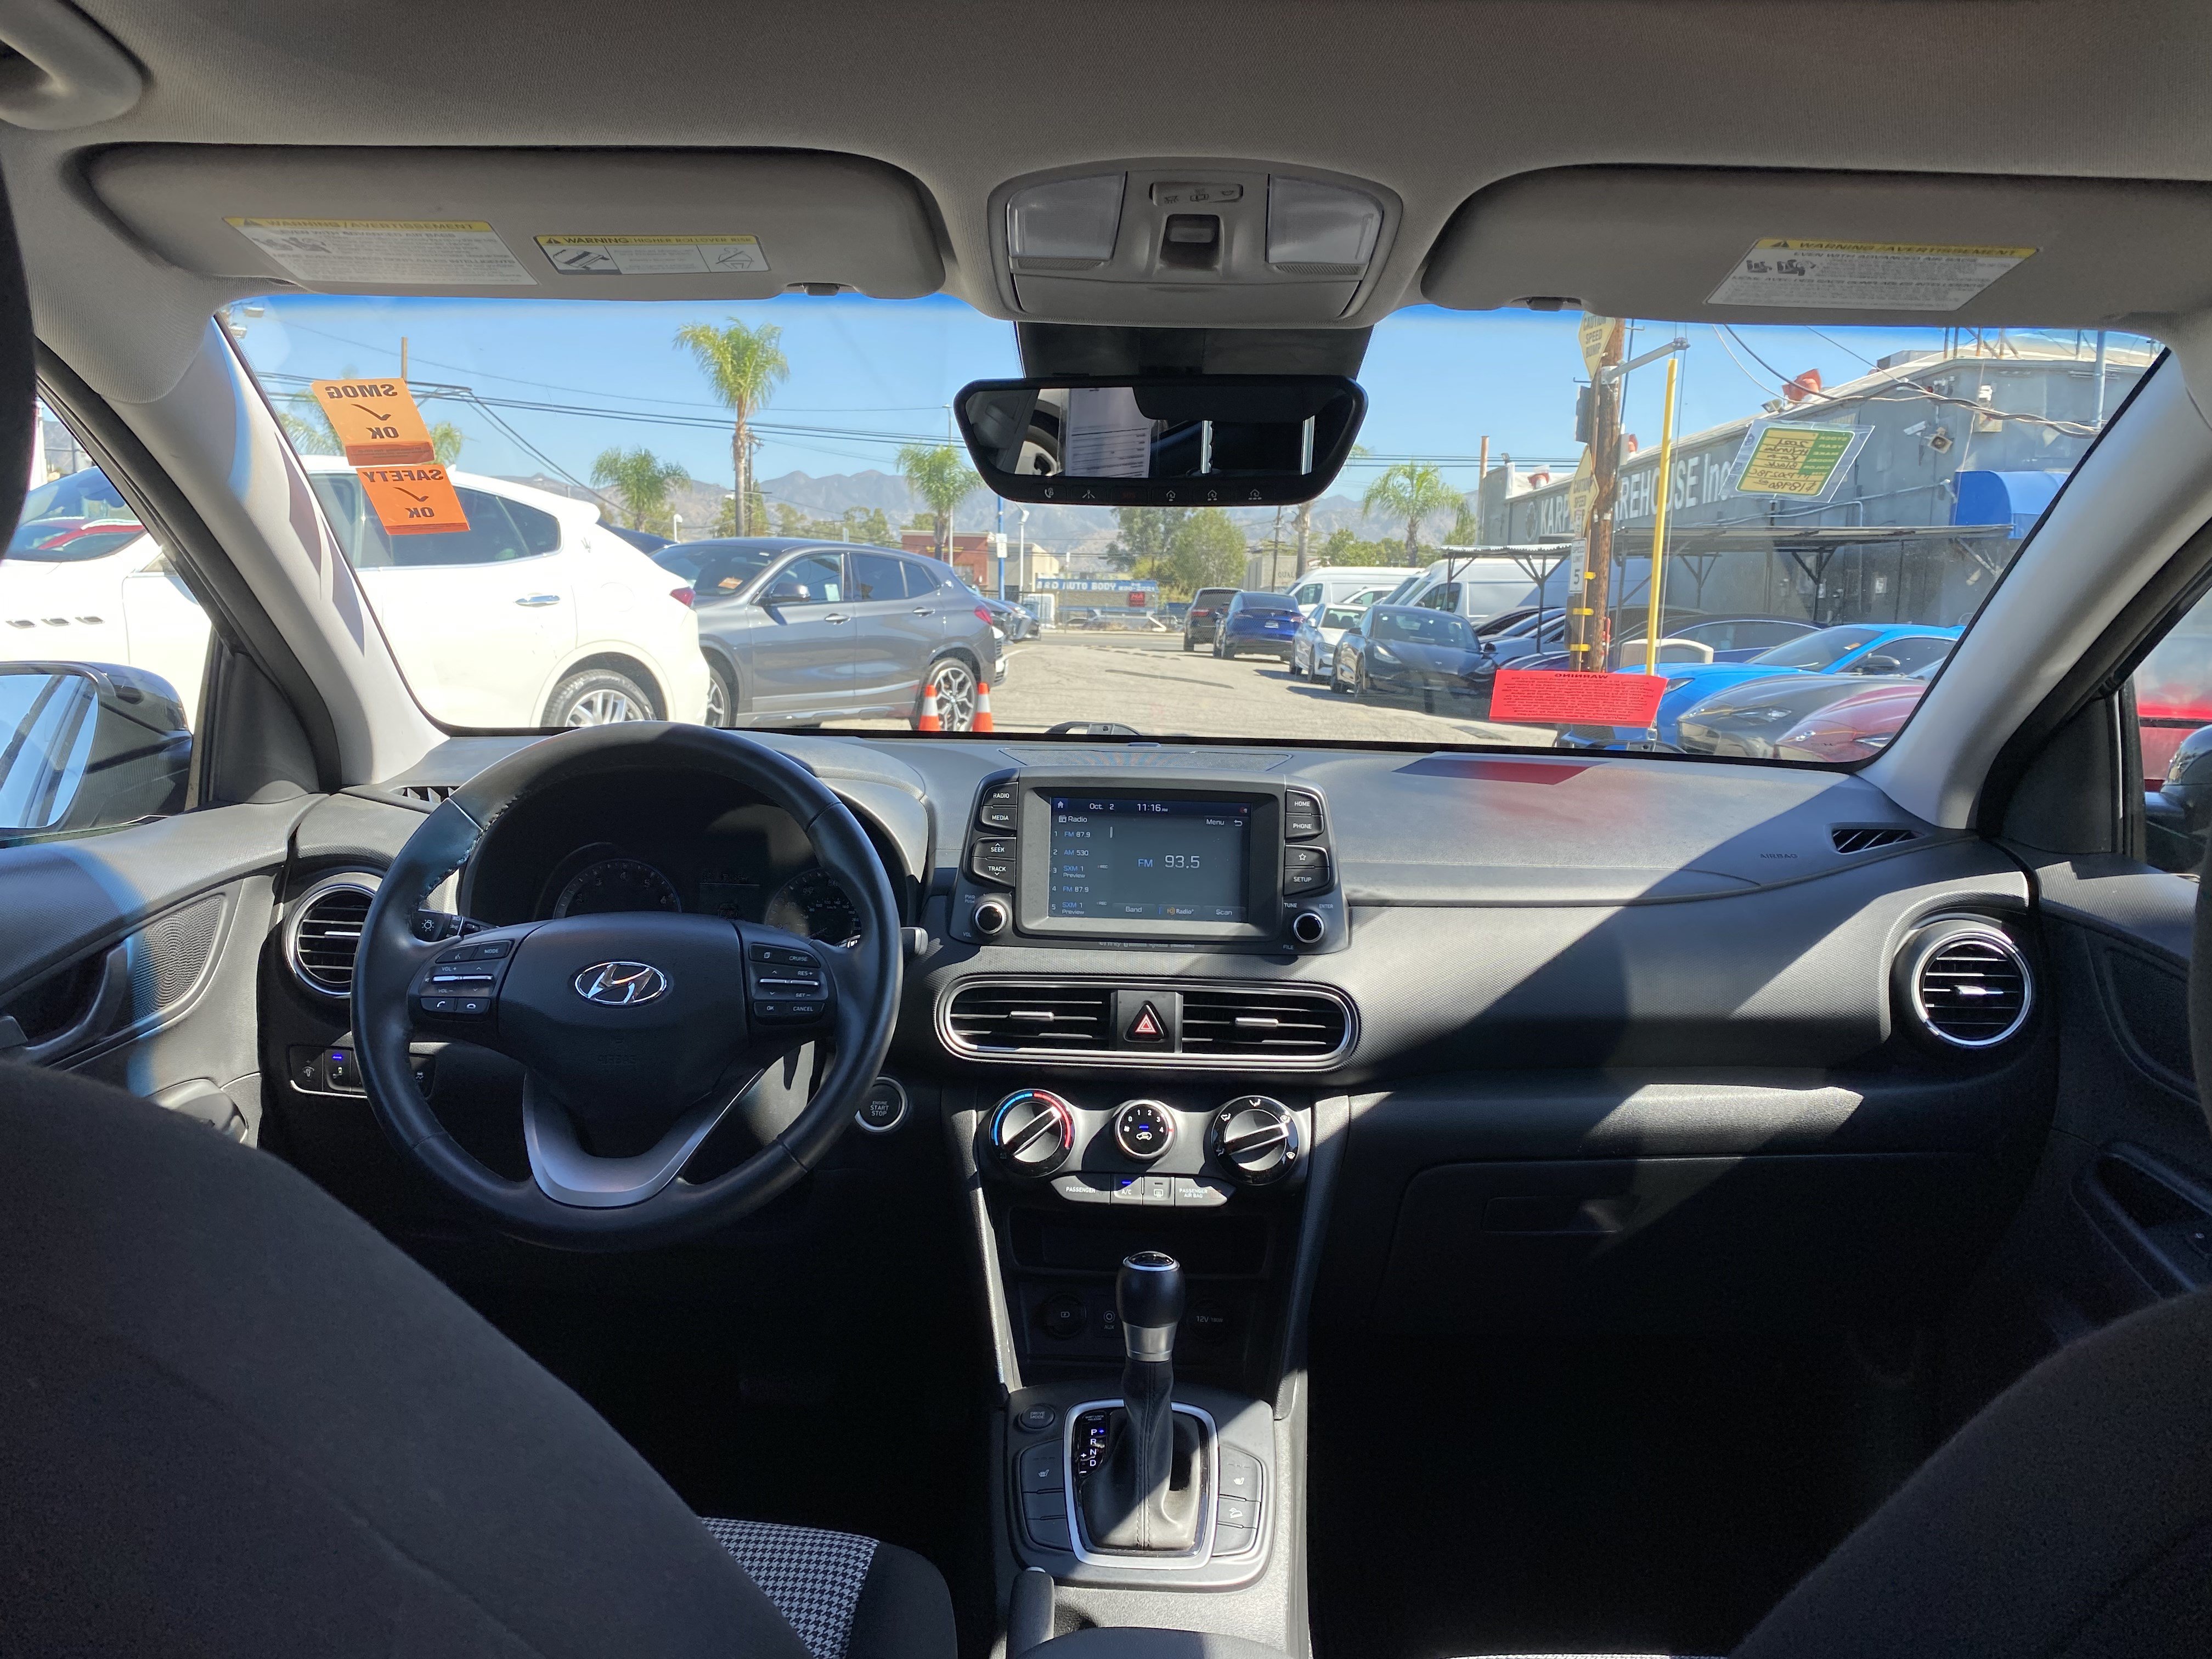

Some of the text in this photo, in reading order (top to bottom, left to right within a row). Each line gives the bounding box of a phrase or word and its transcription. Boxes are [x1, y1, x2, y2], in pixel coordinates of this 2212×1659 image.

[1573, 555, 1583, 563] LIMIT
[1574, 569, 1581, 584] 5
[1063, 582, 1088, 590] AUTO
[1091, 583, 1117, 591] BODY
[1137, 803, 1161, 812] 11:16
[1138, 854, 1200, 868] FM 93.5
